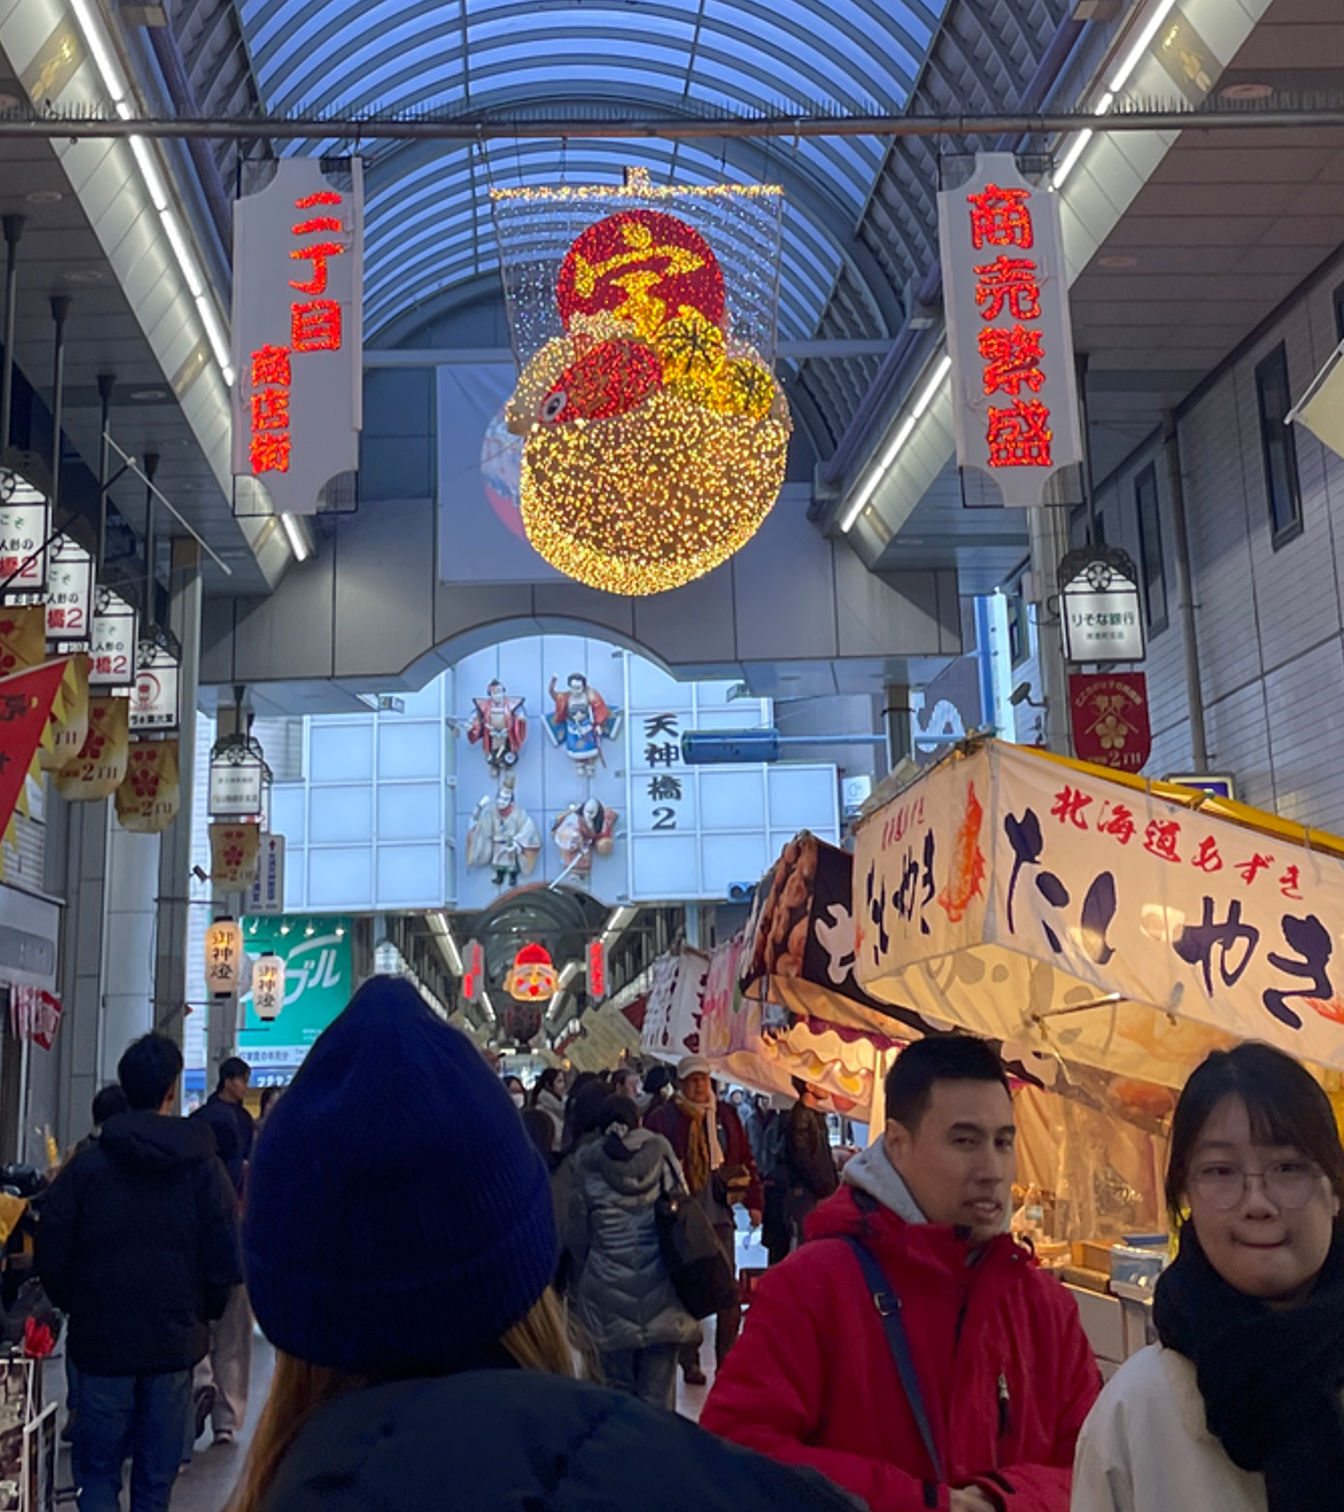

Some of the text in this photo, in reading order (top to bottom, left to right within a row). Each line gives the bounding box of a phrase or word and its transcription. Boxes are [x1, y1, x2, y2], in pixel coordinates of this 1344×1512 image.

[286, 191, 346, 354] 二丁目
[967, 182, 1054, 470] 商売繁盛
[1071, 611, 1136, 627] りそな銀行
[643, 712, 683, 831] 天神橋2
[1050, 784, 1307, 902] 北海道あずき
